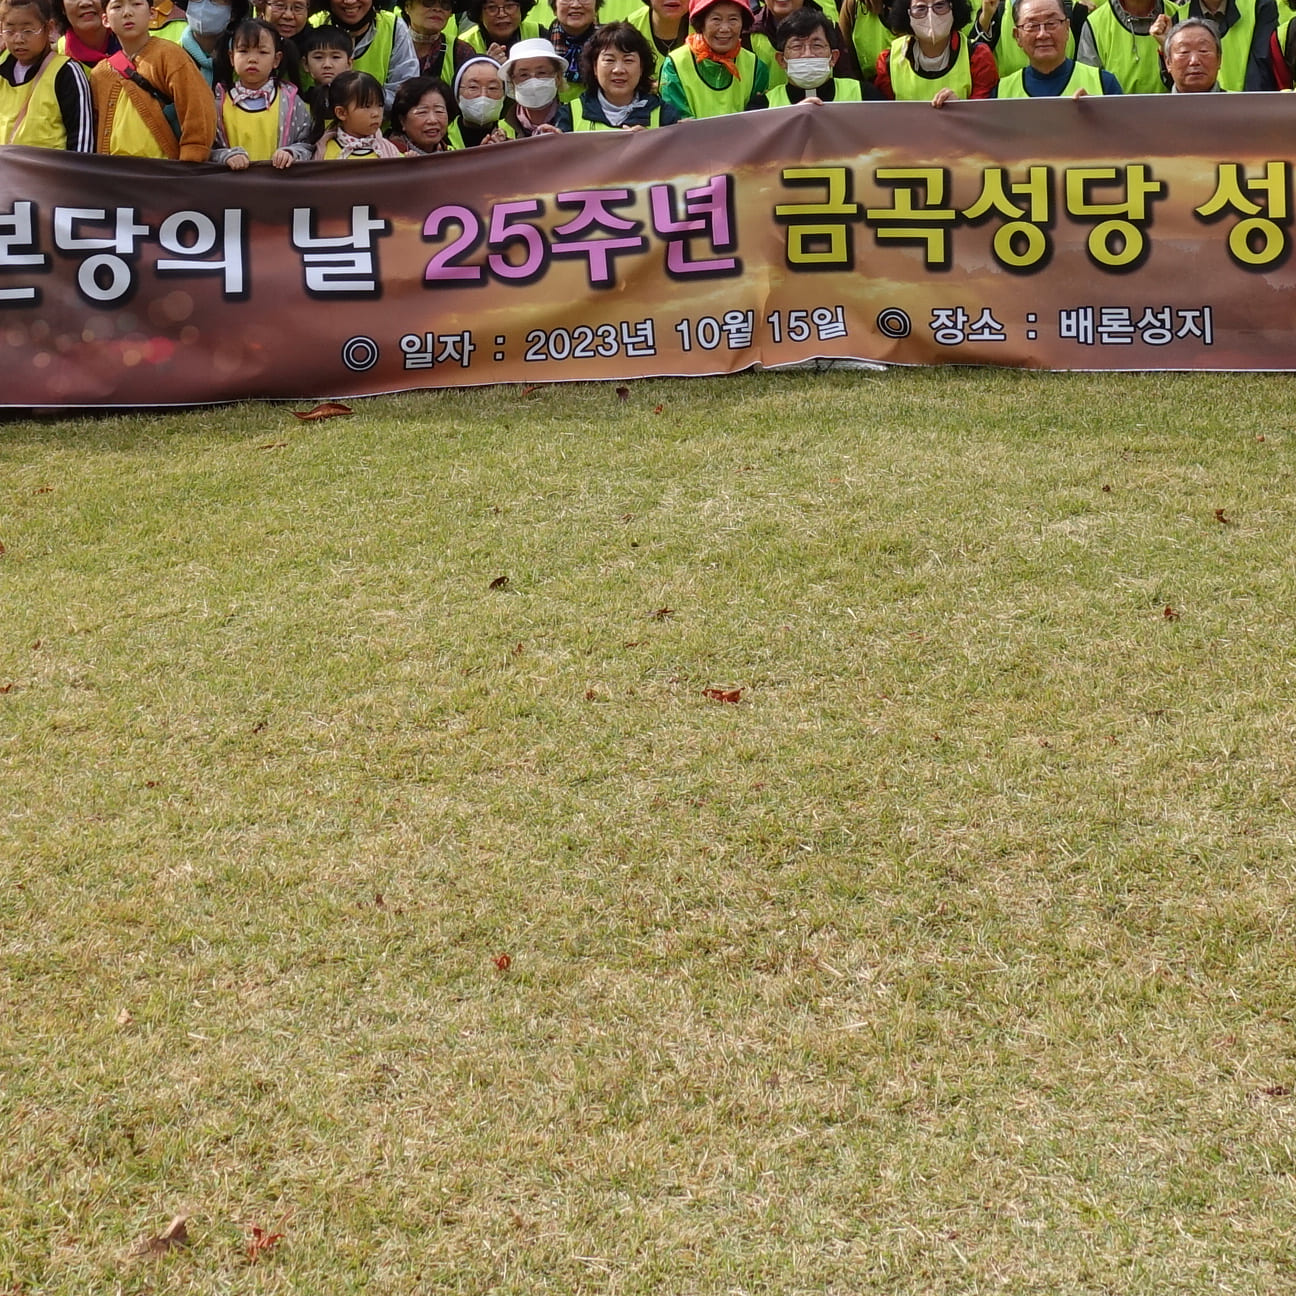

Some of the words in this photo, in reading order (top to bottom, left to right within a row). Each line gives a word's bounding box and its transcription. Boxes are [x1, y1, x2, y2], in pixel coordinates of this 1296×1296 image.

[291, 203, 386, 292] 날
[423, 173, 738, 288] 25주년
[774, 165, 1164, 266] 금곡성당
[399, 331, 473, 369] 일자
[525, 318, 657, 363] 2023년
[674, 310, 754, 351] 10월
[767, 306, 847, 343] 15일
[930, 307, 1006, 345] 장소
[1060, 306, 1212, 344] 배론성지
